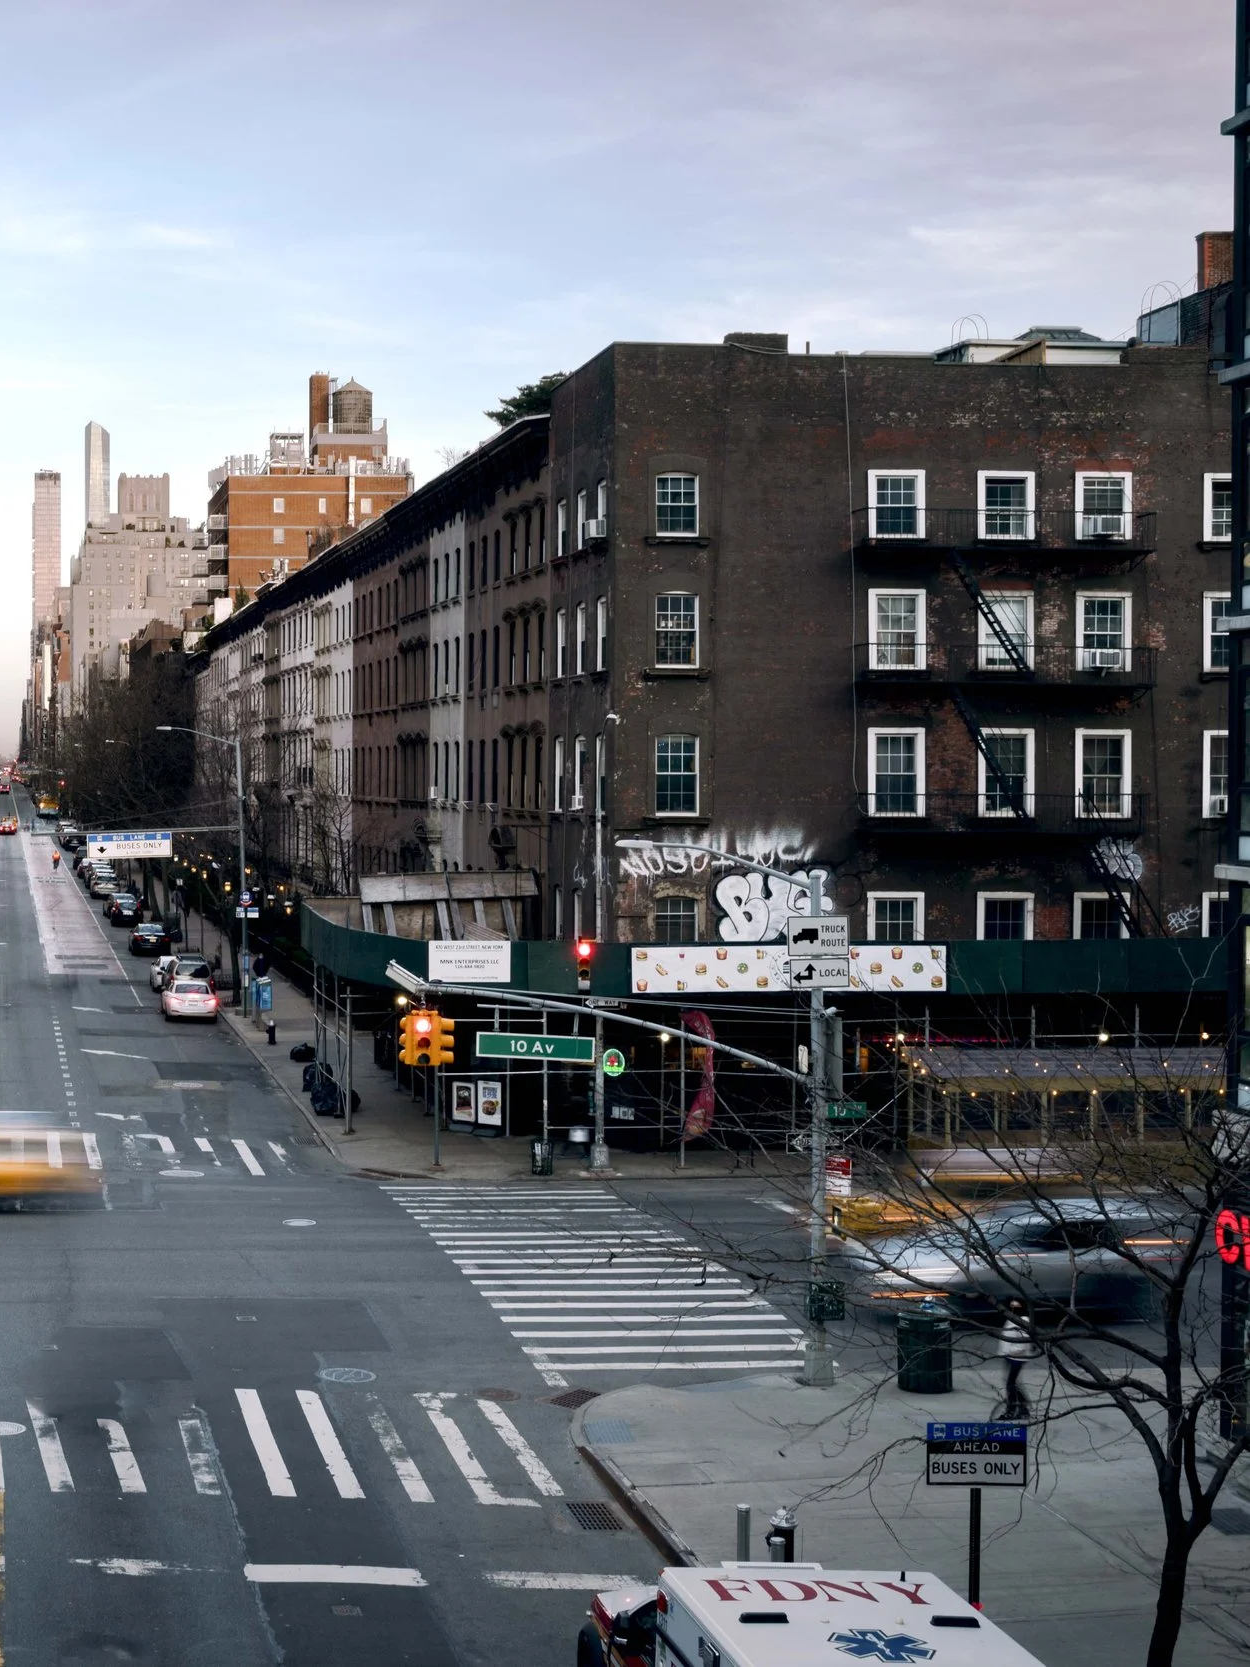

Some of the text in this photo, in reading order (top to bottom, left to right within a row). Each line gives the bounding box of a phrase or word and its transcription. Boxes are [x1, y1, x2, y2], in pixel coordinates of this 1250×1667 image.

[116, 841, 162, 850] BUSES ONLY
[820, 925, 846, 933] TRUCK
[820, 938, 846, 947] ROUTE
[819, 968, 847, 977] LOCAL
[510, 1040, 555, 1054] 10 Av
[953, 1426, 980, 1437] BUS
[953, 1442, 1000, 1452] AHEAD
[932, 1461, 1021, 1475] BUSES ONLY
[701, 1578, 932, 1605] FDNY
